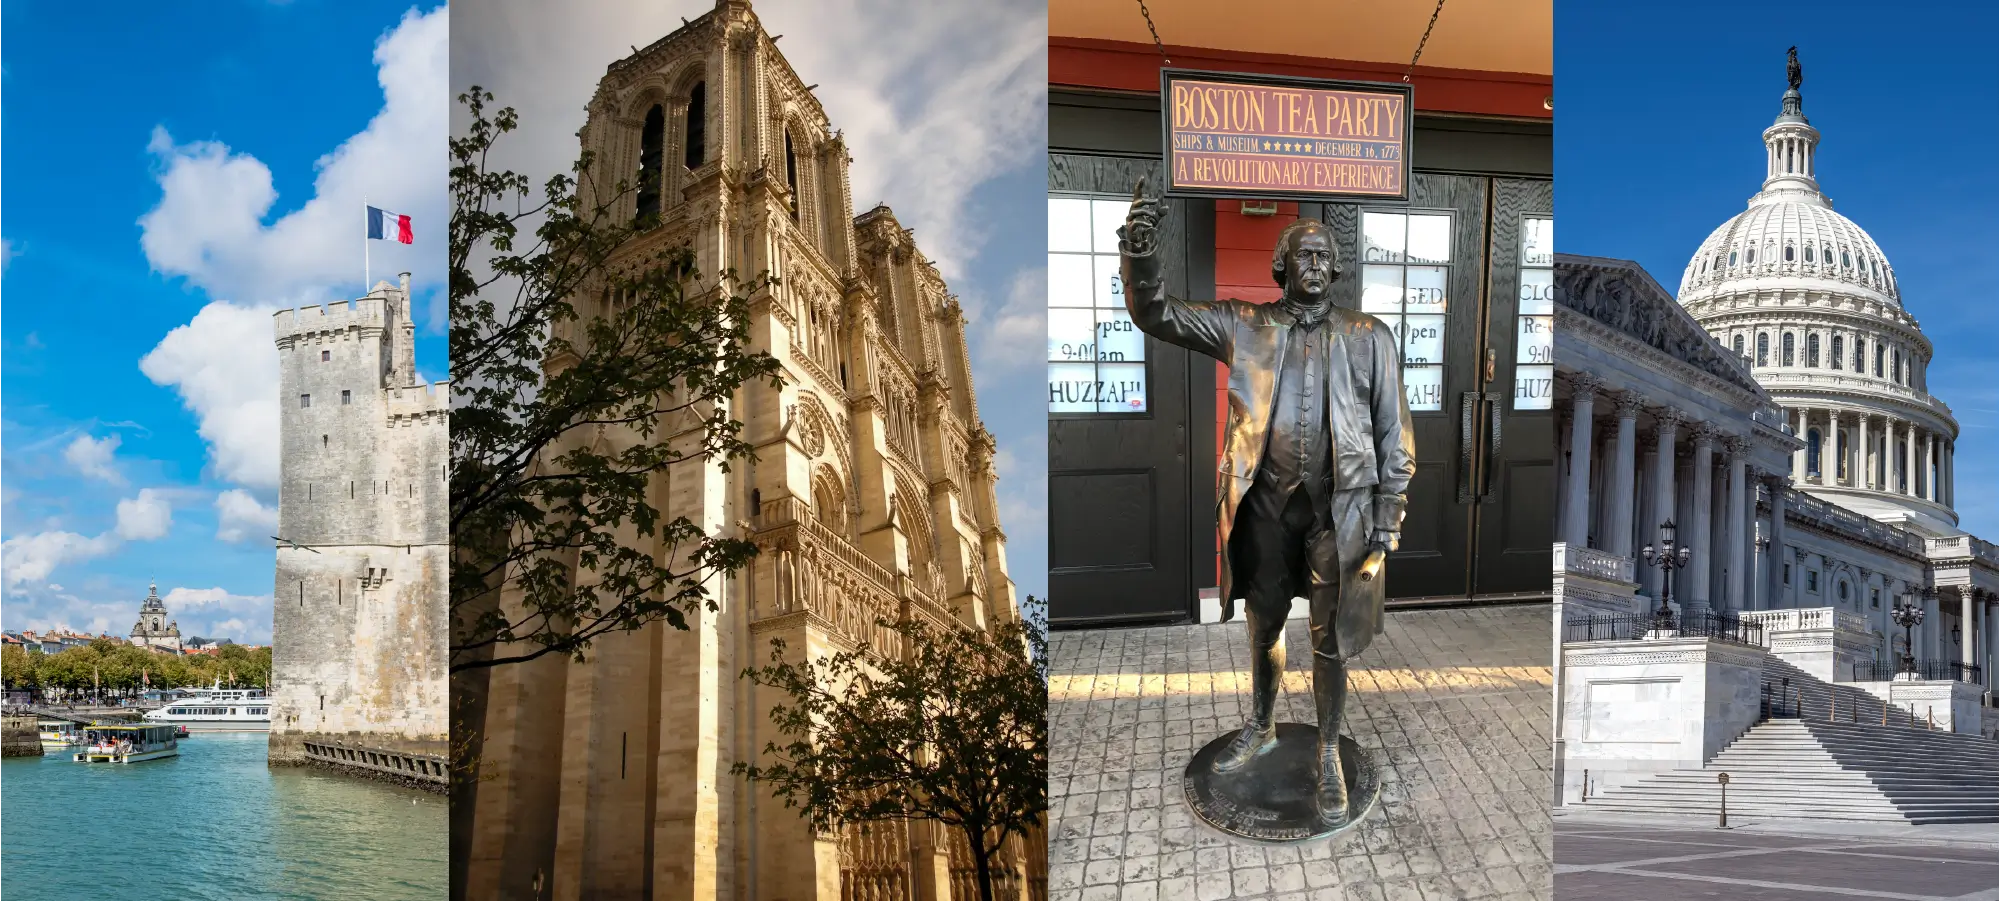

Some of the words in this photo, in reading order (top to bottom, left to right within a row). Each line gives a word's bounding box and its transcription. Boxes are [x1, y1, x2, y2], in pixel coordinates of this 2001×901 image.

[1175, 86, 1266, 132] BOSTON
[1273, 92, 1319, 135] TEA
[1325, 96, 1400, 138] PARTY
[1174, 133, 1202, 150] SHIPS
[1206, 135, 1214, 151] &
[1315, 141, 1361, 157] DECEMBER
[1365, 144, 1378, 159] 16,
[1381, 145, 1400, 160] 1773
[1178, 156, 1188, 181] A
[1193, 157, 1311, 186] REVOLUTIONARY
[1529, 345, 1553, 363] 9:0
[1049, 380, 1141, 403] HUZZAH!
